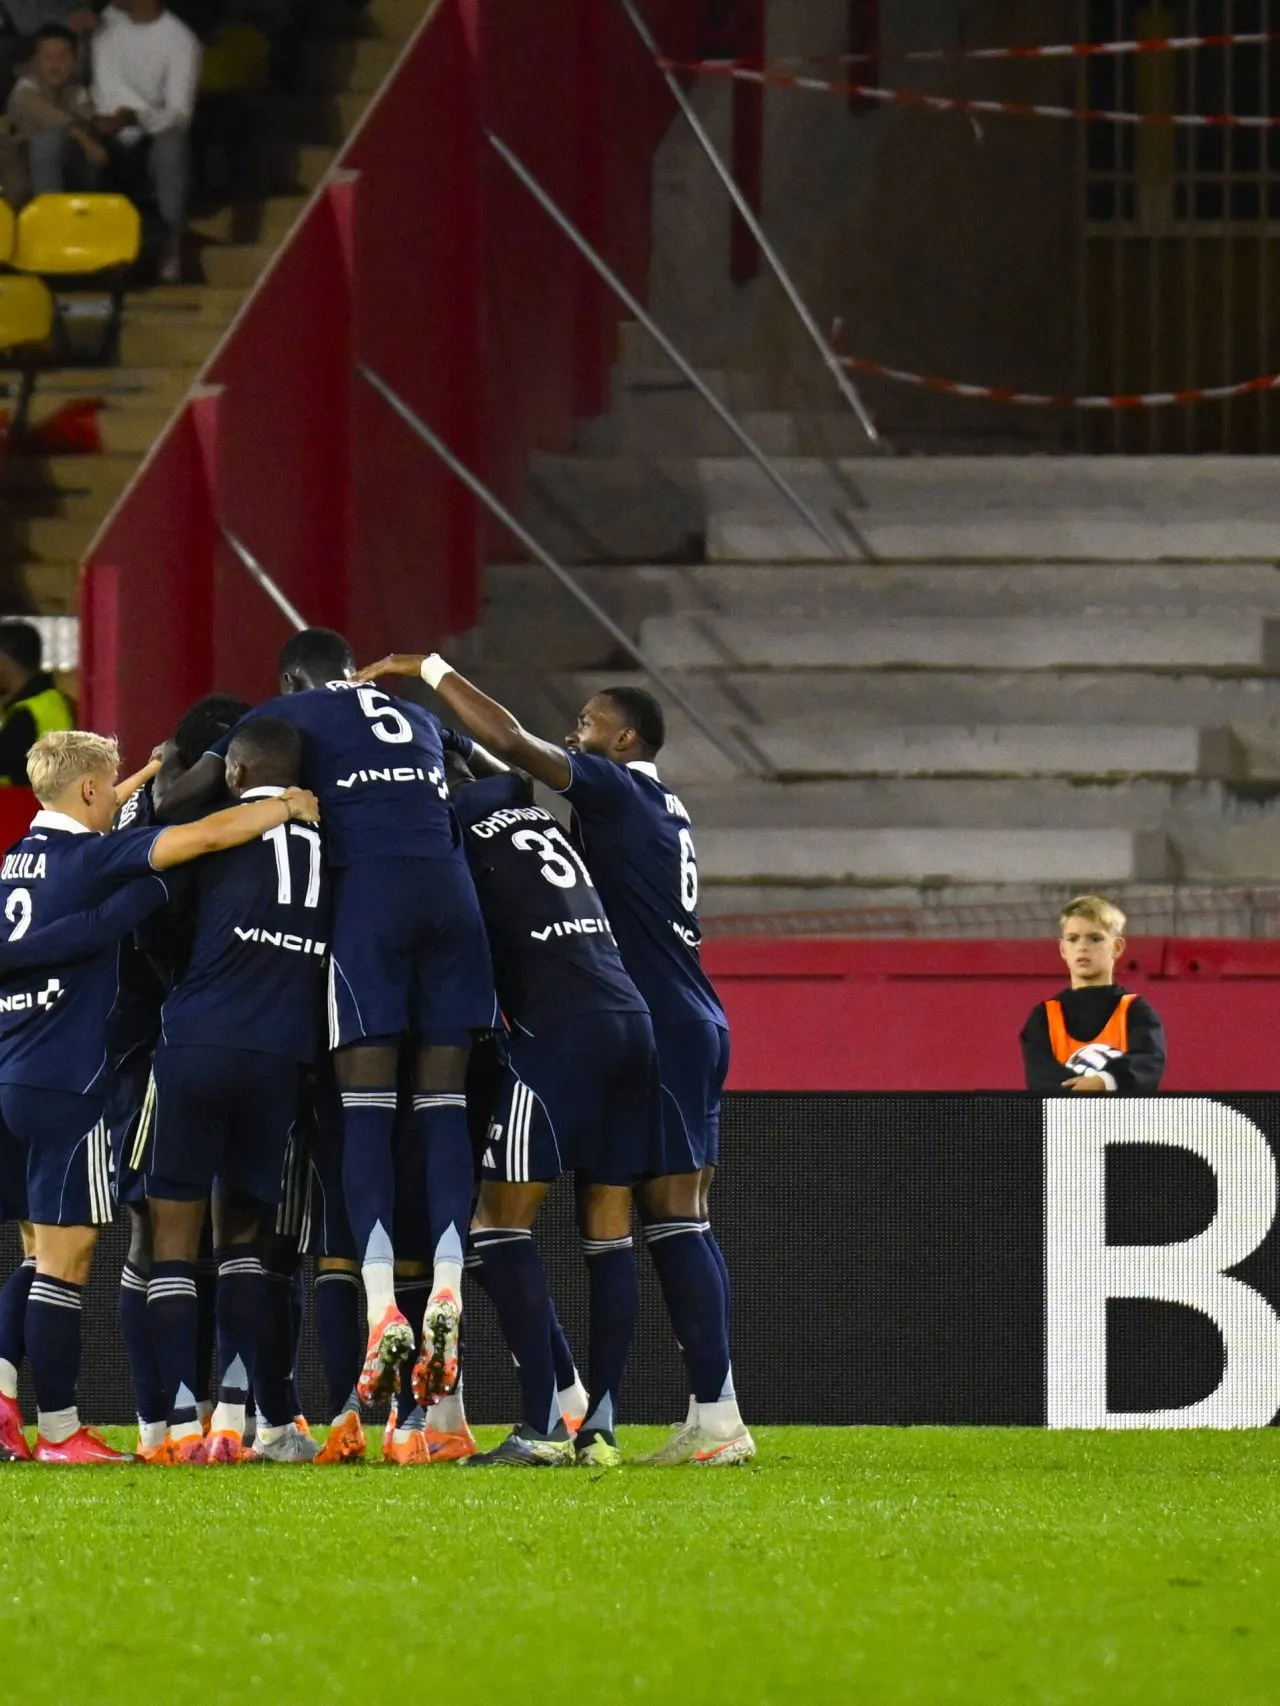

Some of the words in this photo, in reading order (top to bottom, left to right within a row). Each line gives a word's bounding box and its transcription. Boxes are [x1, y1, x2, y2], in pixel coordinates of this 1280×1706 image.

[356, 687, 414, 744] 5
[336, 767, 424, 789] VINCI
[0, 852, 47, 880] OLLILA
[262, 823, 322, 909] 17
[510, 826, 595, 889] 31
[678, 827, 699, 912] 6
[3, 886, 33, 943] 2
[233, 926, 312, 954] VINCI
[530, 918, 604, 941] VINCI
